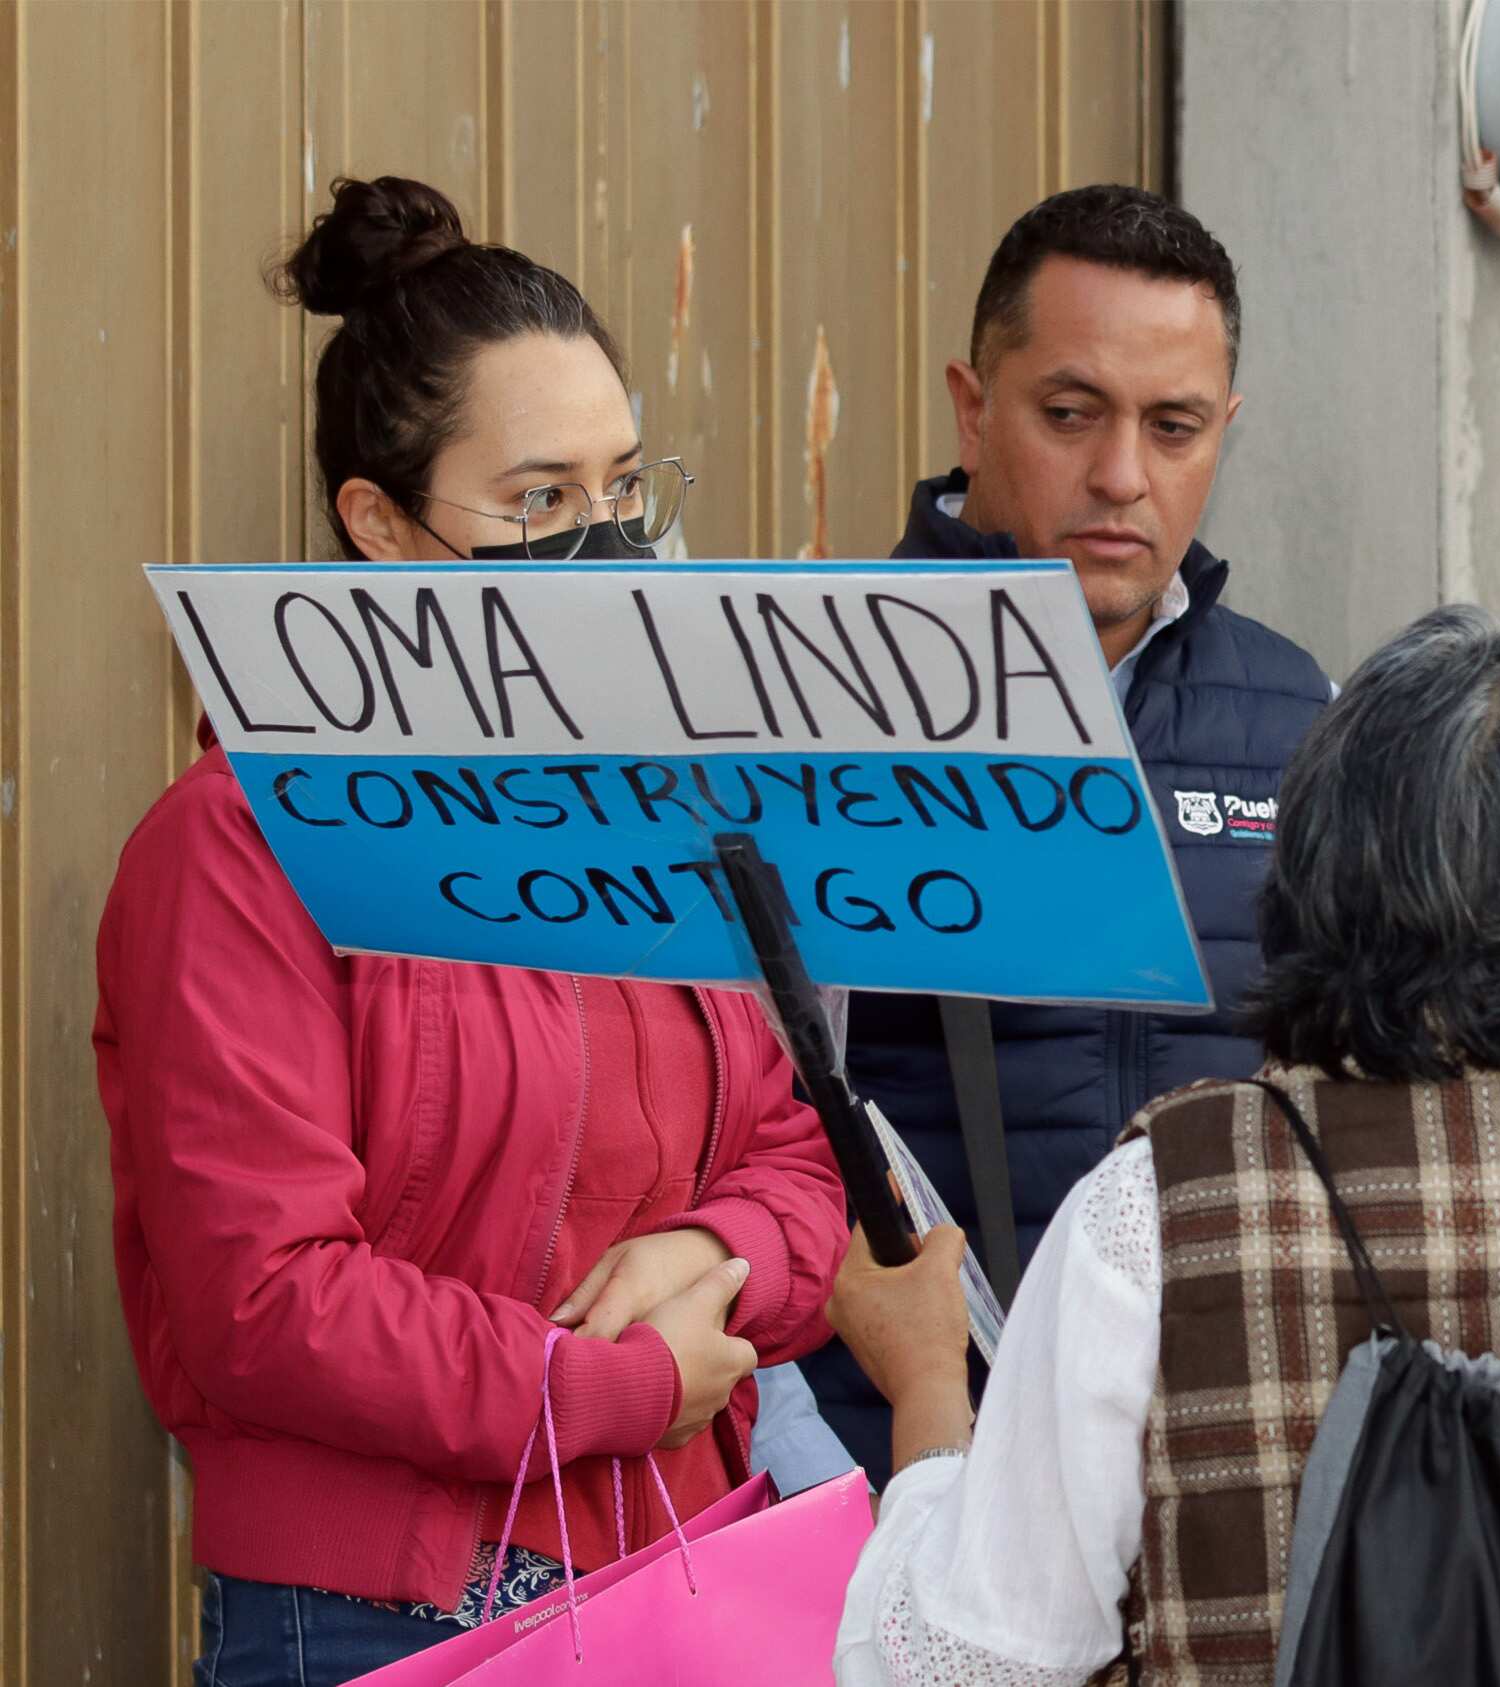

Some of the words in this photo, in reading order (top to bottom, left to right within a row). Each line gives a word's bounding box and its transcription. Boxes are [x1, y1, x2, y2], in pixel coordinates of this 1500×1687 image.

[177, 587, 583, 740] LOMA
[632, 588, 1091, 744] LINDA
[273, 761, 1142, 835] CONSTRUYENDO
